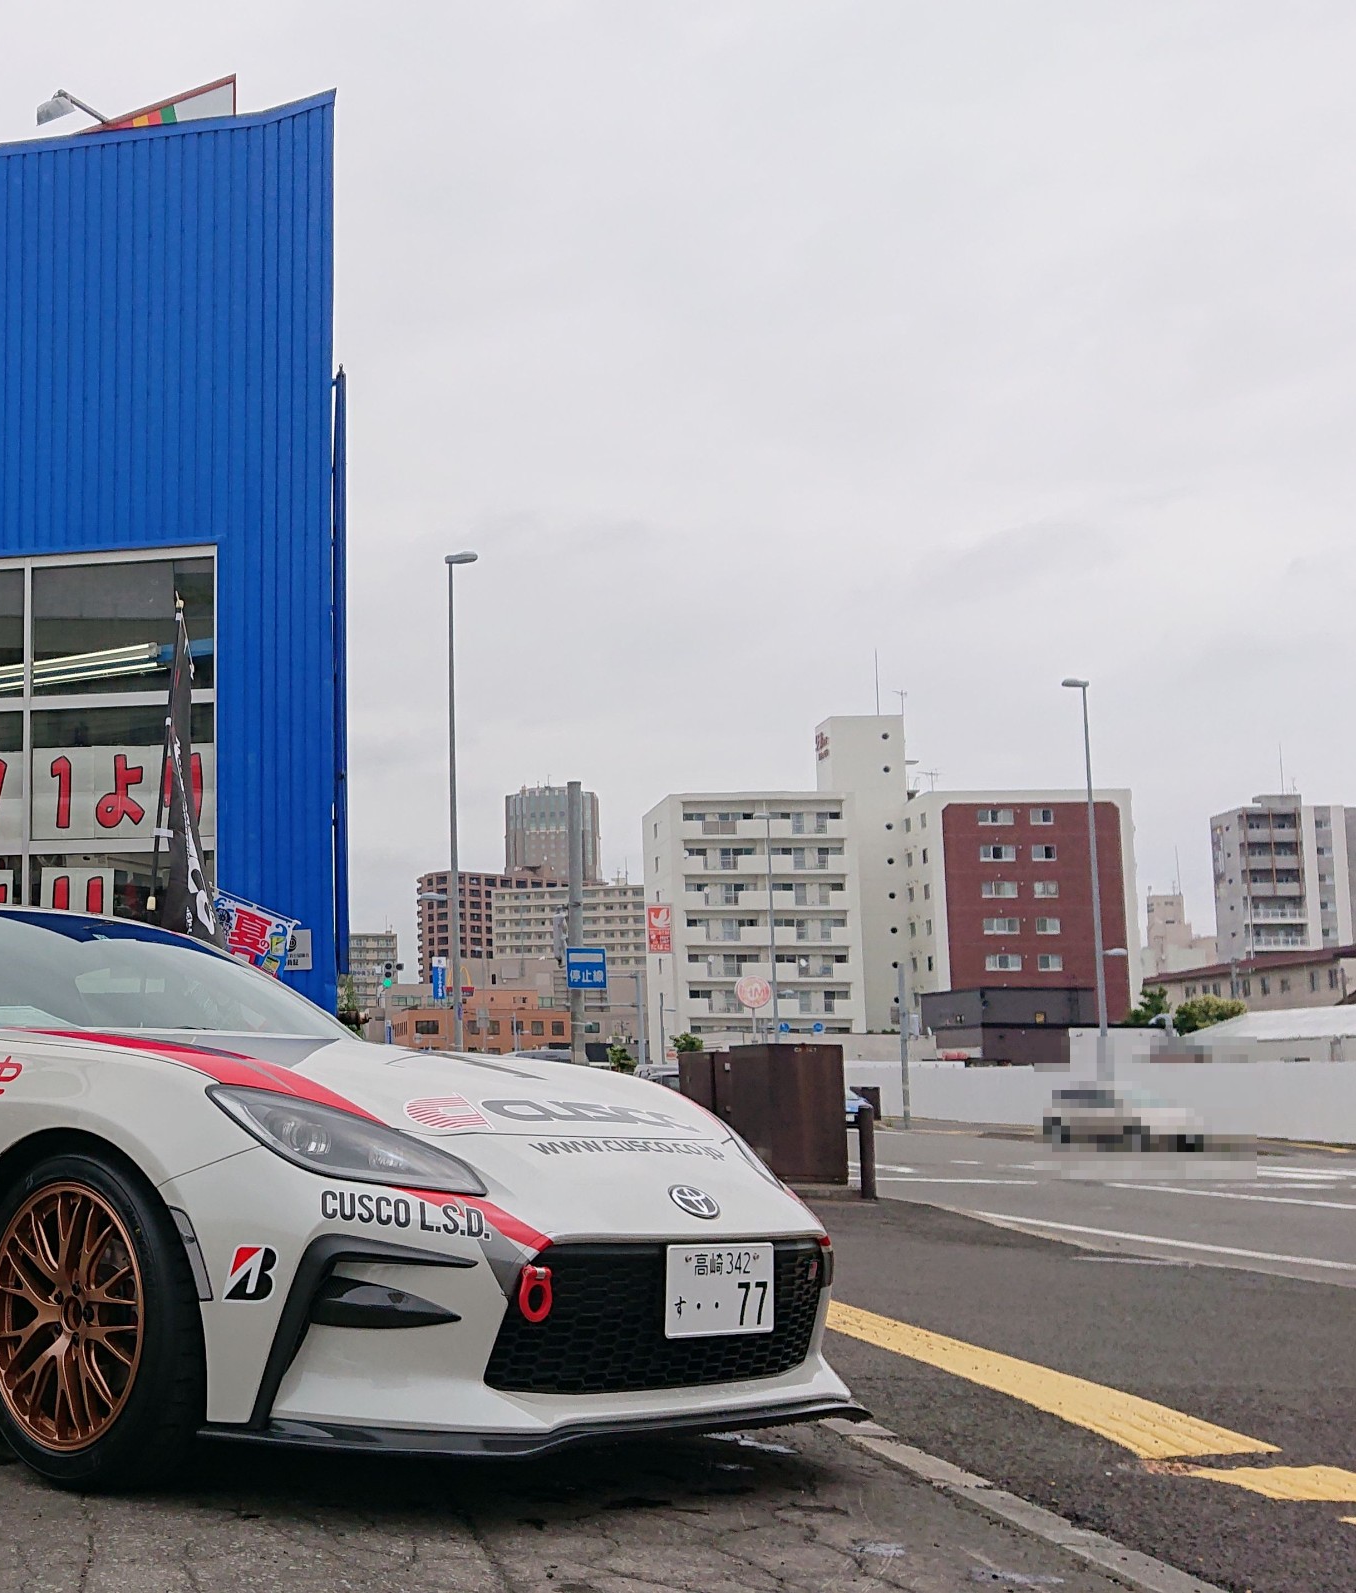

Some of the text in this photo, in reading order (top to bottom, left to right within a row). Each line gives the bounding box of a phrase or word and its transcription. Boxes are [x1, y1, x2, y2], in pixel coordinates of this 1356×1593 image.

[570, 969, 604, 983] 停止線
[529, 1140, 726, 1163] www.cusco.co.jp
[321, 1190, 491, 1241] CUSCO L.S.D.
[694, 1252, 751, 1276] 高崎 342
[674, 1295, 687, 1320] す
